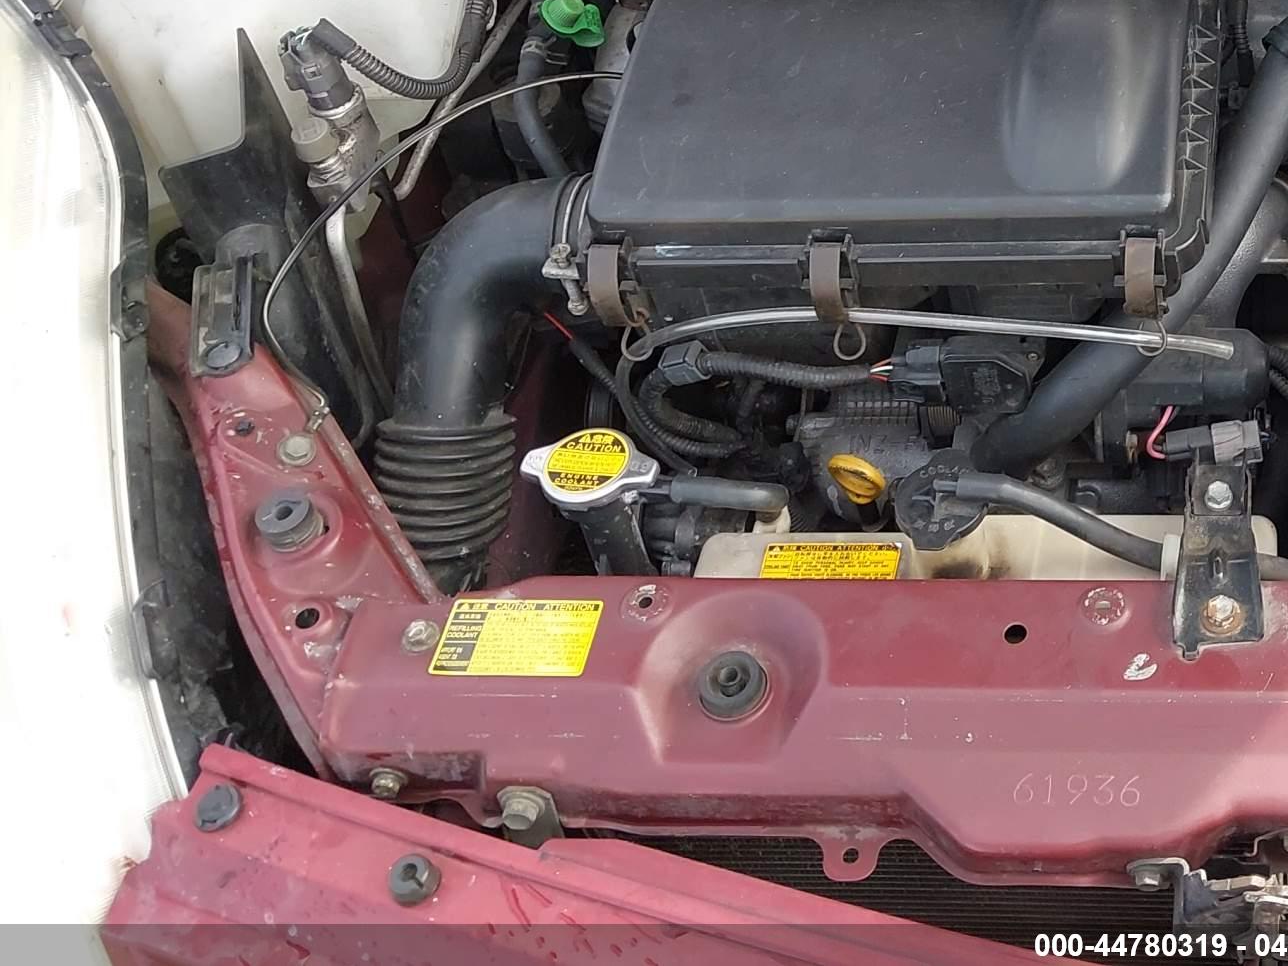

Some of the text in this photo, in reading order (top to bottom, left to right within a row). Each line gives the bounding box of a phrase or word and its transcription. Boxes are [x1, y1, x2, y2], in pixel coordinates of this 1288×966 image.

[566, 442, 622, 453] CAUTION
[554, 477, 600, 487] COOLANT
[494, 602, 537, 611] CAUTION
[543, 602, 595, 611] ATTENTION
[449, 624, 482, 632] REFILLING
[446, 631, 479, 639] COOLANT
[1013, 772, 1140, 807] 61936
